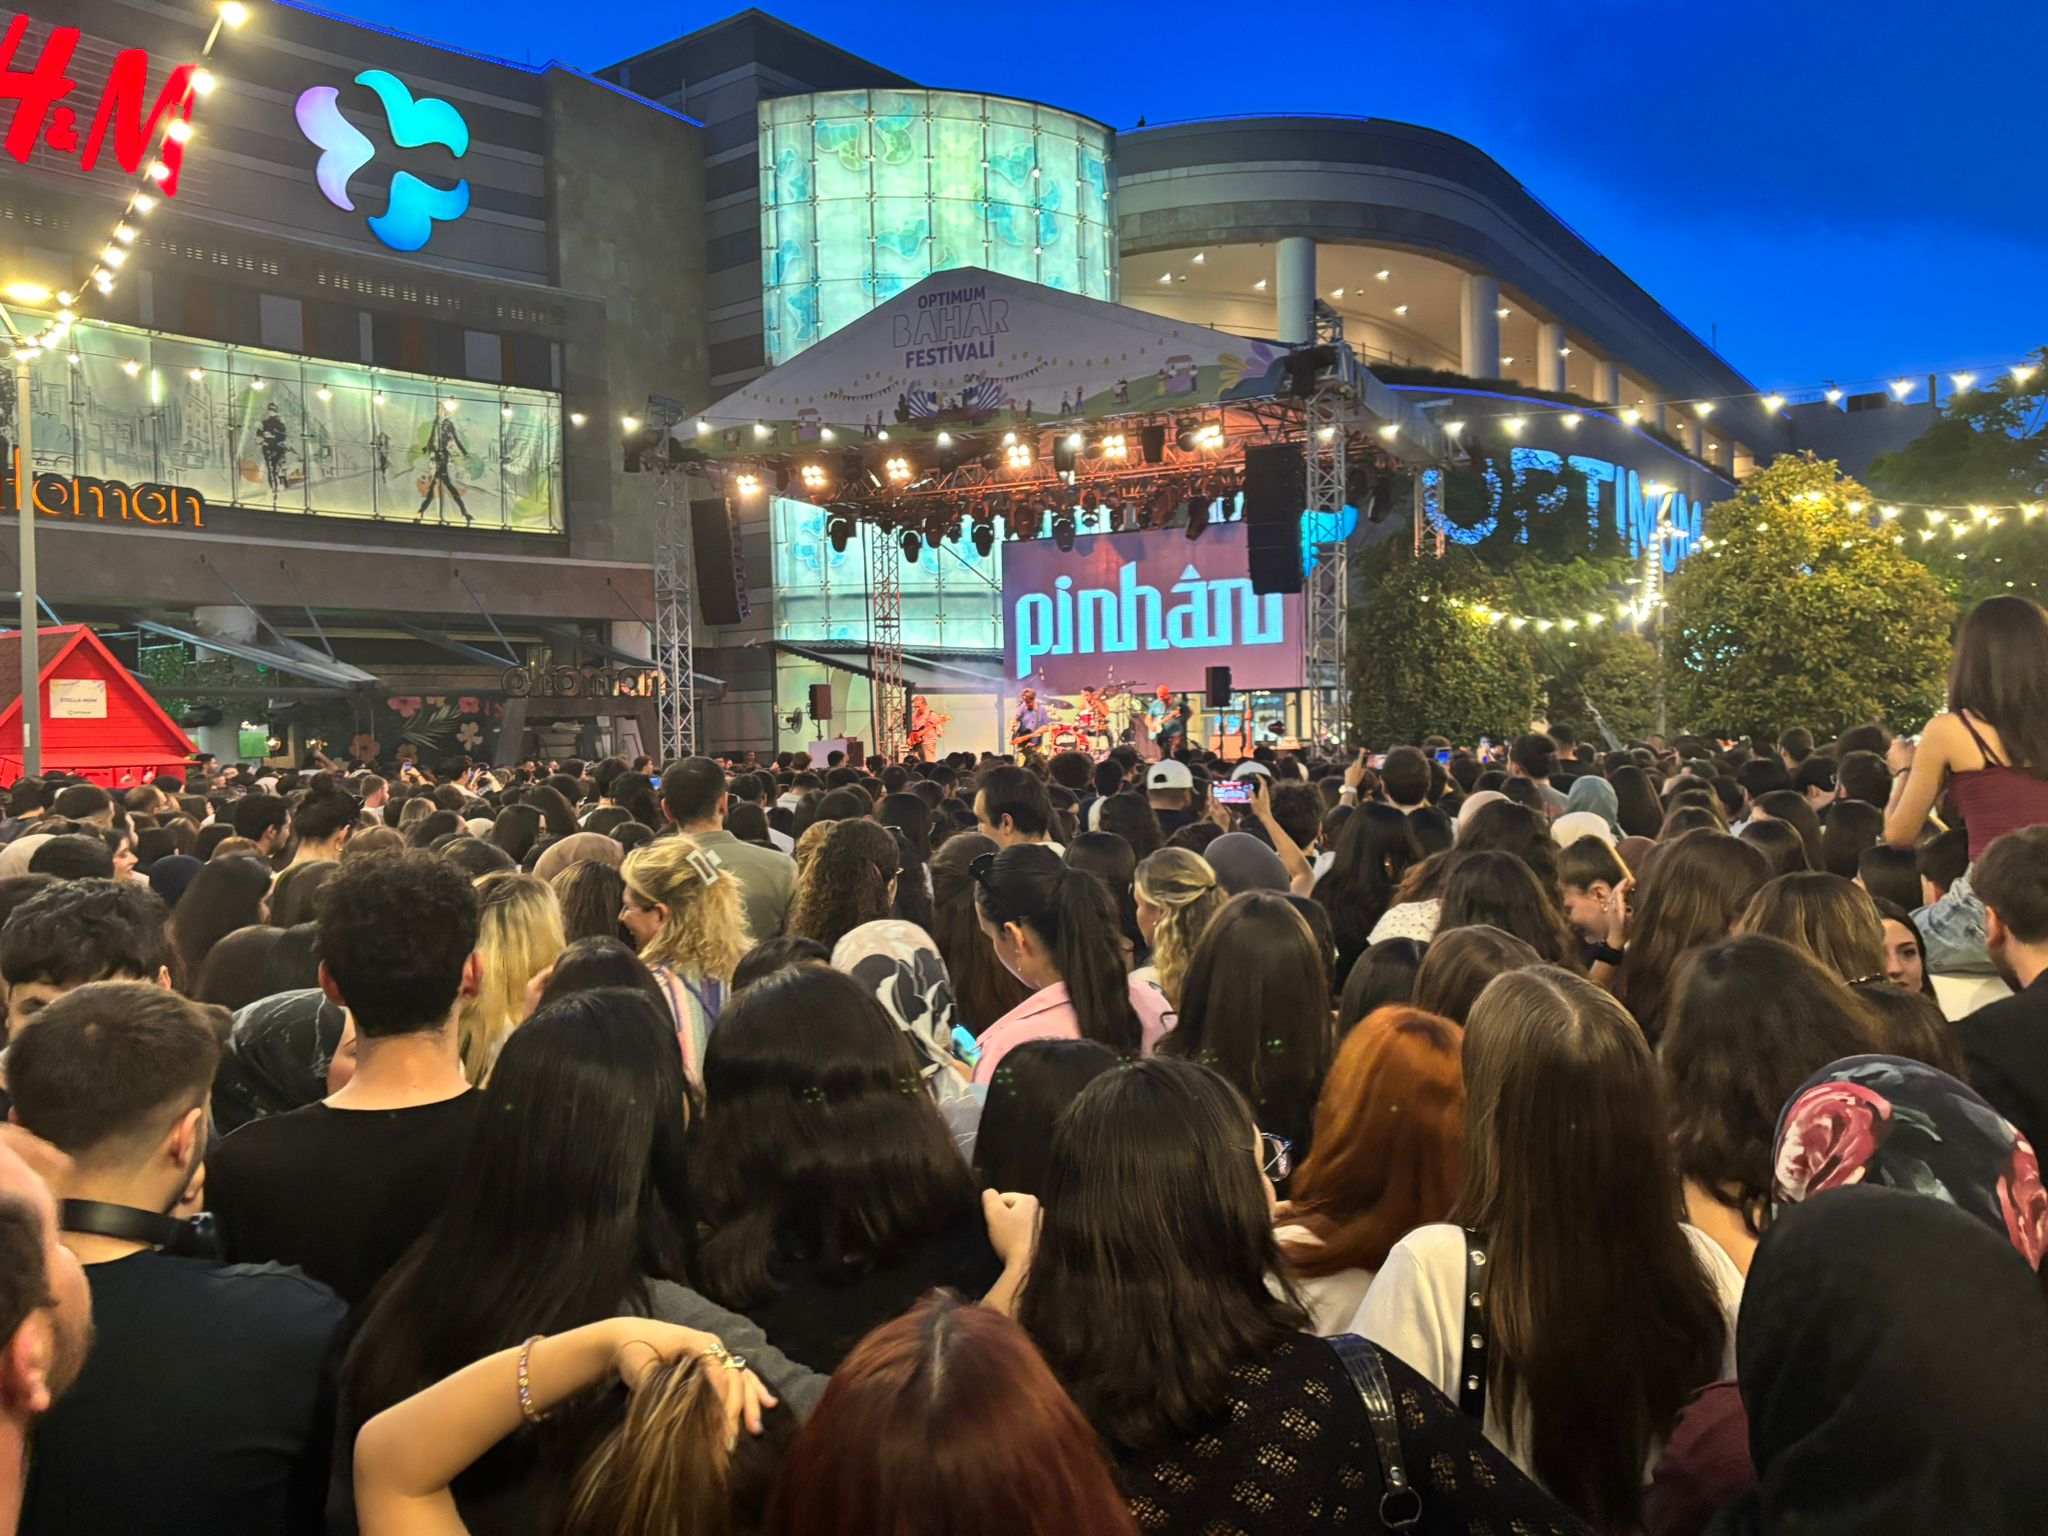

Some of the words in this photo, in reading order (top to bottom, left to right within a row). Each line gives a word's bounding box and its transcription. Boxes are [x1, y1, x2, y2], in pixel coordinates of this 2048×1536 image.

[0, 13, 197, 198] H&M
[917, 285, 986, 309] OPTIMUM
[893, 299, 1009, 348] BAHAR
[905, 335, 995, 369] FESTİVALİ
